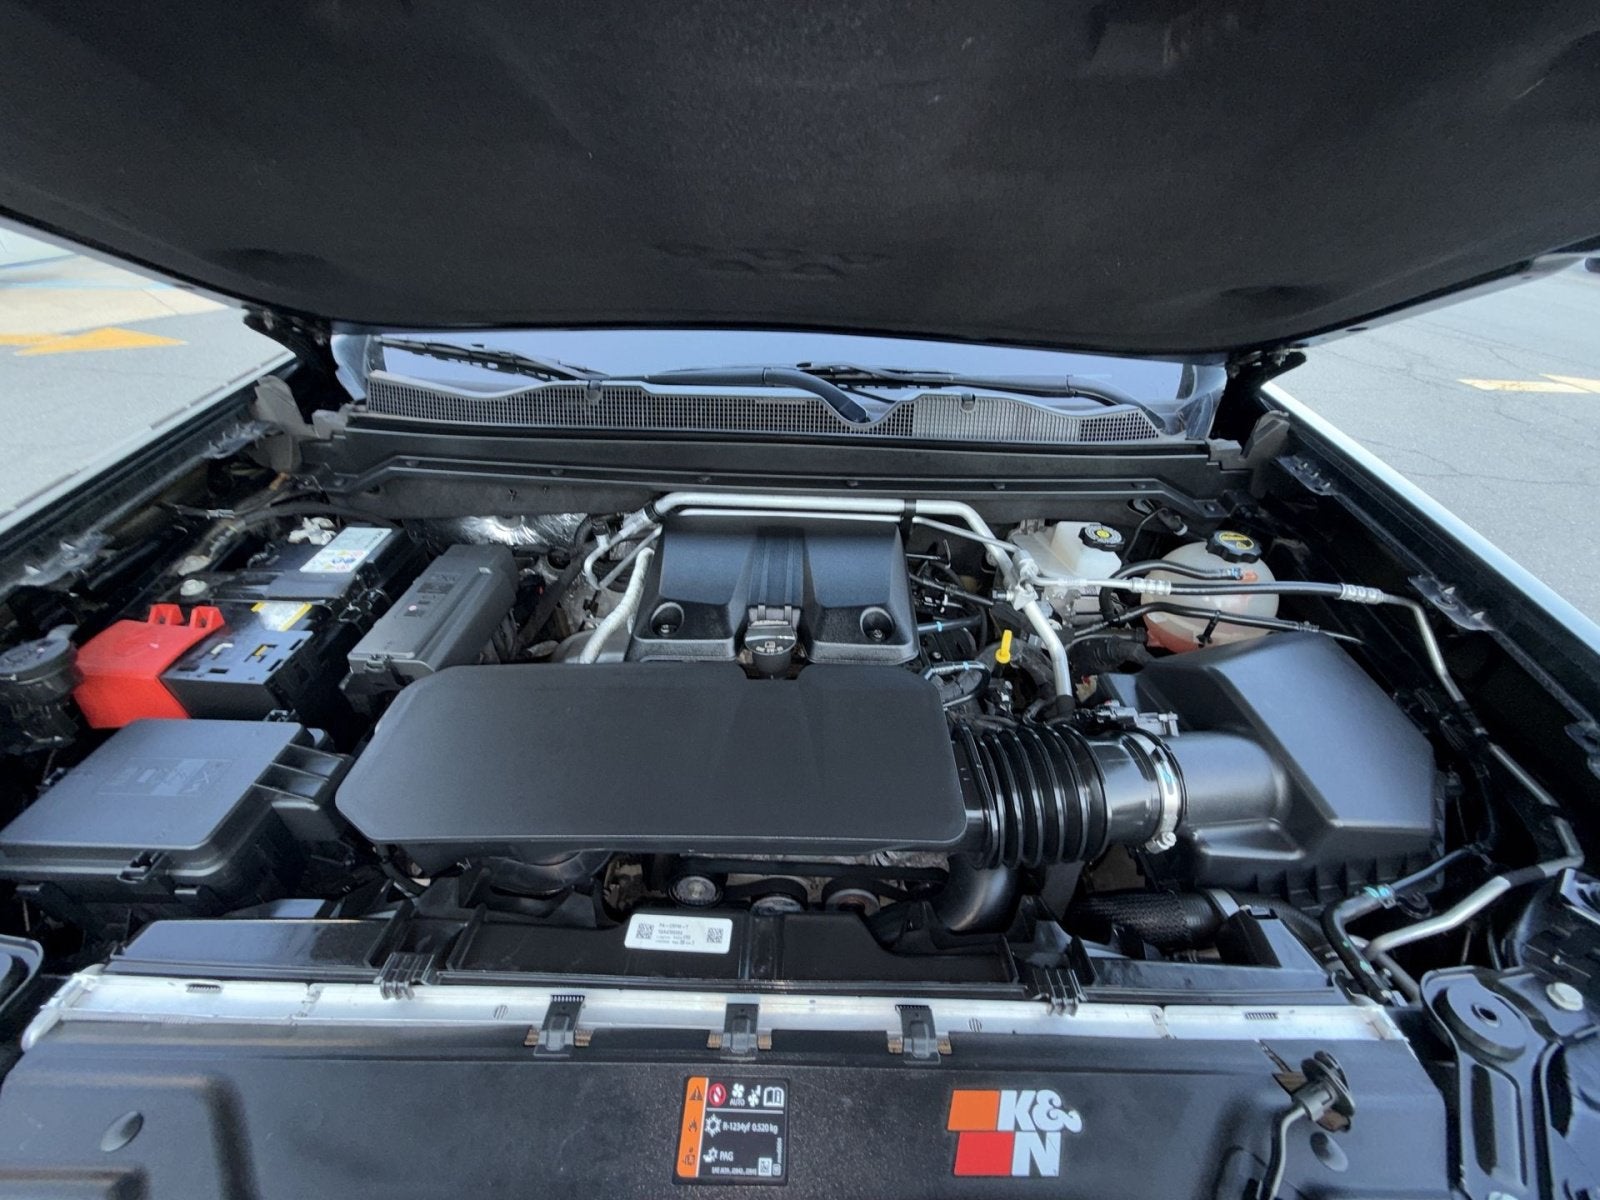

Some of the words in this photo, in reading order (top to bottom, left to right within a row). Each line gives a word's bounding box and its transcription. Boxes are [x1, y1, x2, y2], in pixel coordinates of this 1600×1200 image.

[729, 1098, 746, 1107] AUTO
[997, 1089, 1082, 1133] K&
[722, 1121, 751, 1134] R-1234yf
[751, 1122, 769, 1133] 0.520
[769, 1122, 778, 1135] kg
[719, 1151, 734, 1162] PAG
[1011, 1131, 1061, 1177] N
